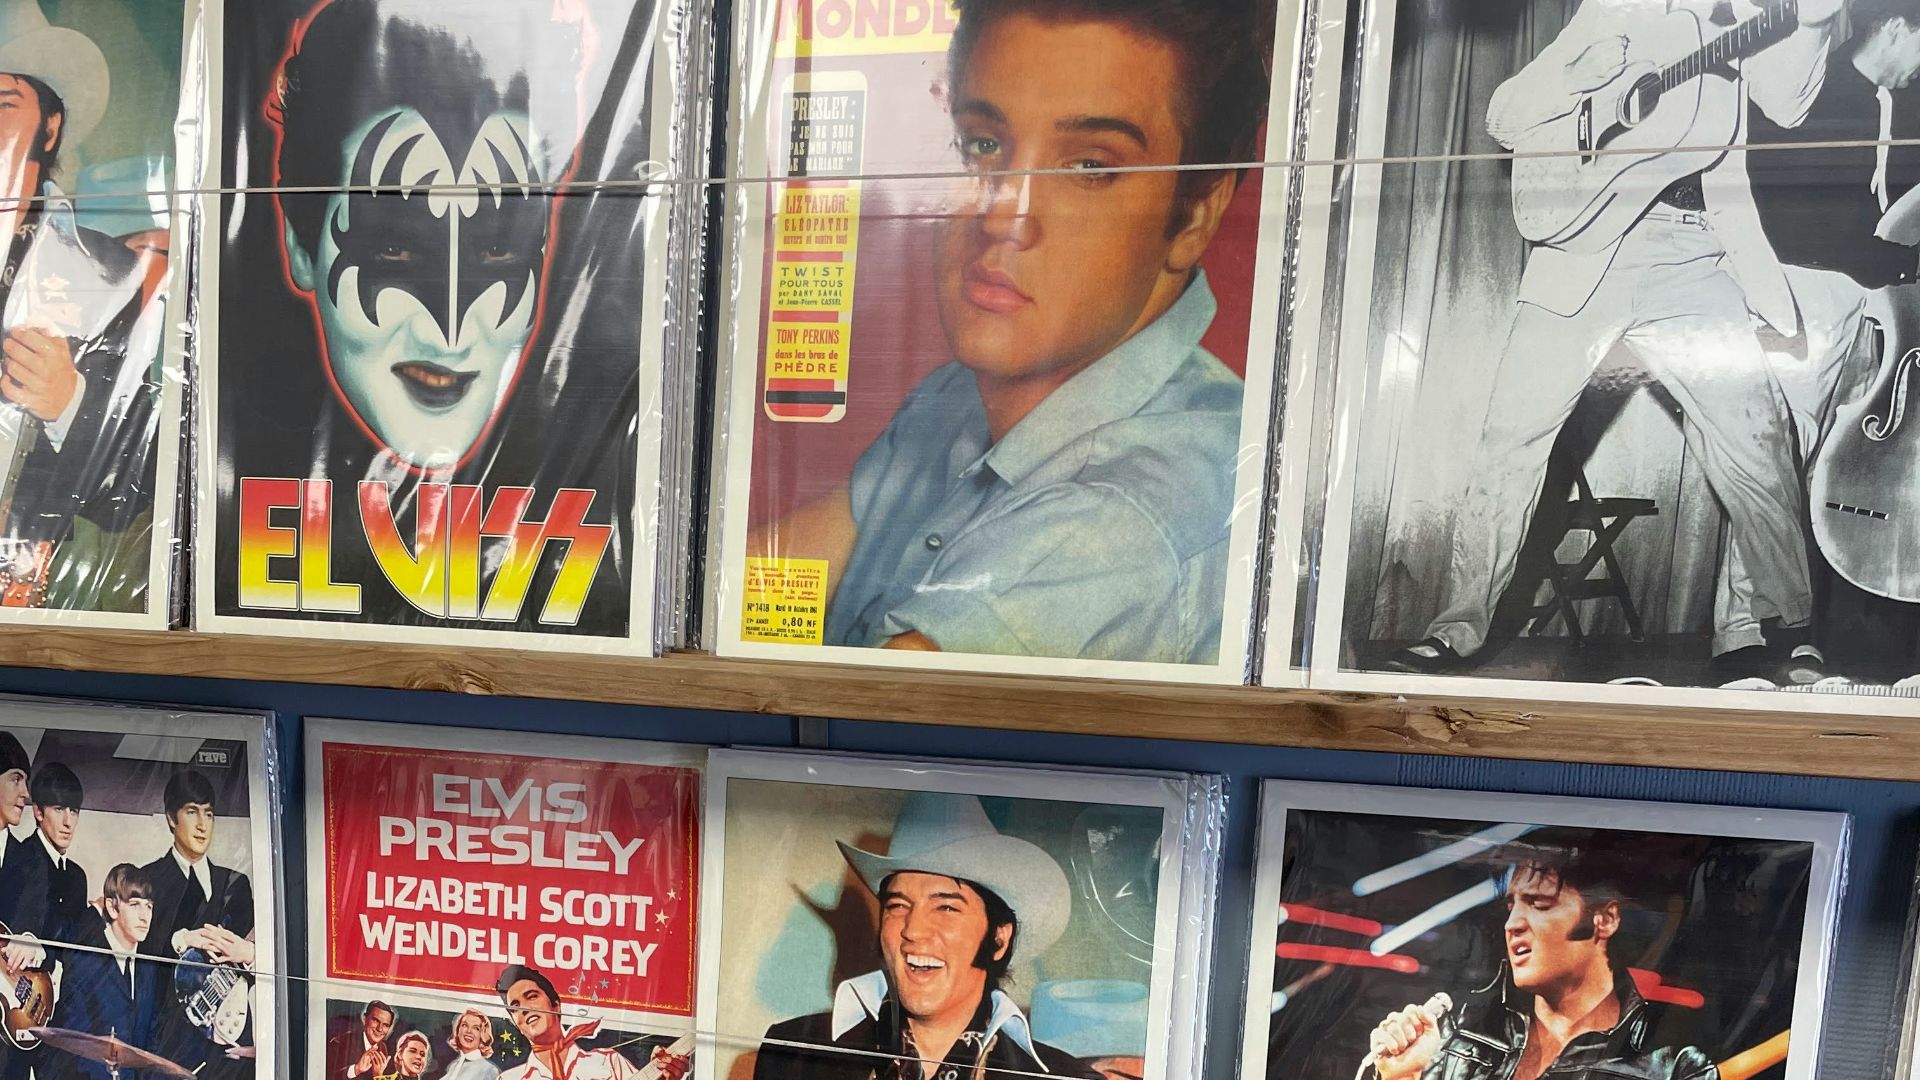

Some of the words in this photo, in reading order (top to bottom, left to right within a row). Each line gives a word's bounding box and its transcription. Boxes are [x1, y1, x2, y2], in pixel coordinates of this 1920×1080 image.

[831, 141, 853, 154] POUR
[785, 195, 803, 214] LIZ
[781, 266, 844, 277] TWIST
[779, 280, 809, 288] POUR
[776, 328, 799, 344] TONY
[802, 329, 840, 344] PERKINS
[775, 349, 793, 359] dans
[795, 349, 806, 359] les
[828, 350, 839, 360] de
[782, 616, 803, 627] 0,80
[198, 751, 227, 764] rave
[432, 773, 588, 824] ELVIS
[379, 815, 645, 875] PRESLEY
[366, 871, 528, 921] LIZABETH
[539, 886, 653, 932] SCOTT
[358, 913, 526, 966] WENDELL
[533, 932, 659, 977] COREY
